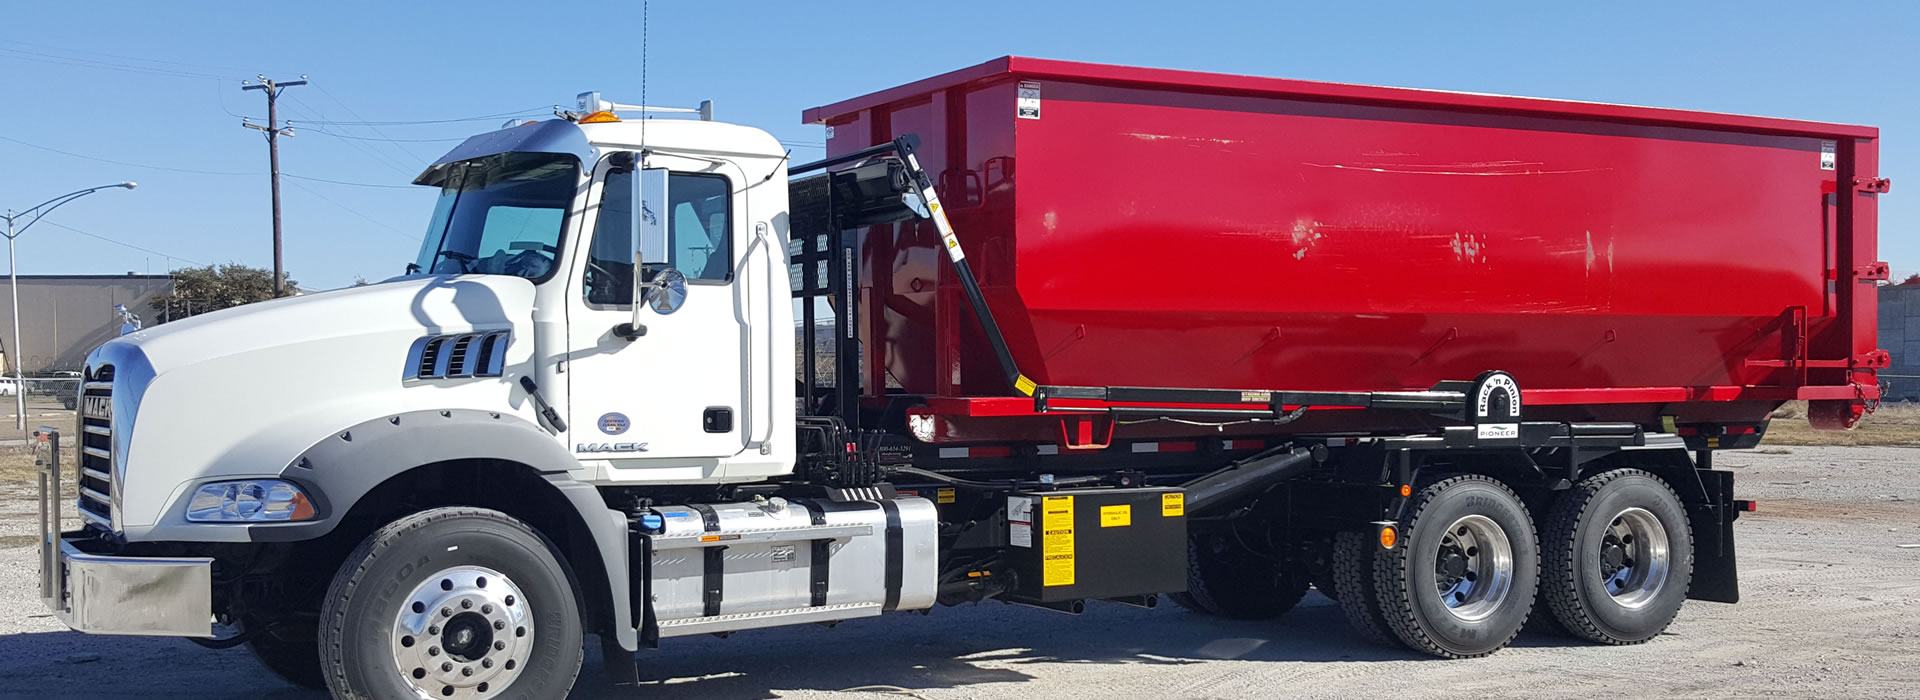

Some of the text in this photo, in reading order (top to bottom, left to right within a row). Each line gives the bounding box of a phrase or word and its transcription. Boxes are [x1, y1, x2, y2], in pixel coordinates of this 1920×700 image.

[1479, 382, 1493, 413] Rack
[1503, 378, 1519, 414] Pinion
[84, 397, 112, 418] MACK
[576, 442, 649, 453] MACK
